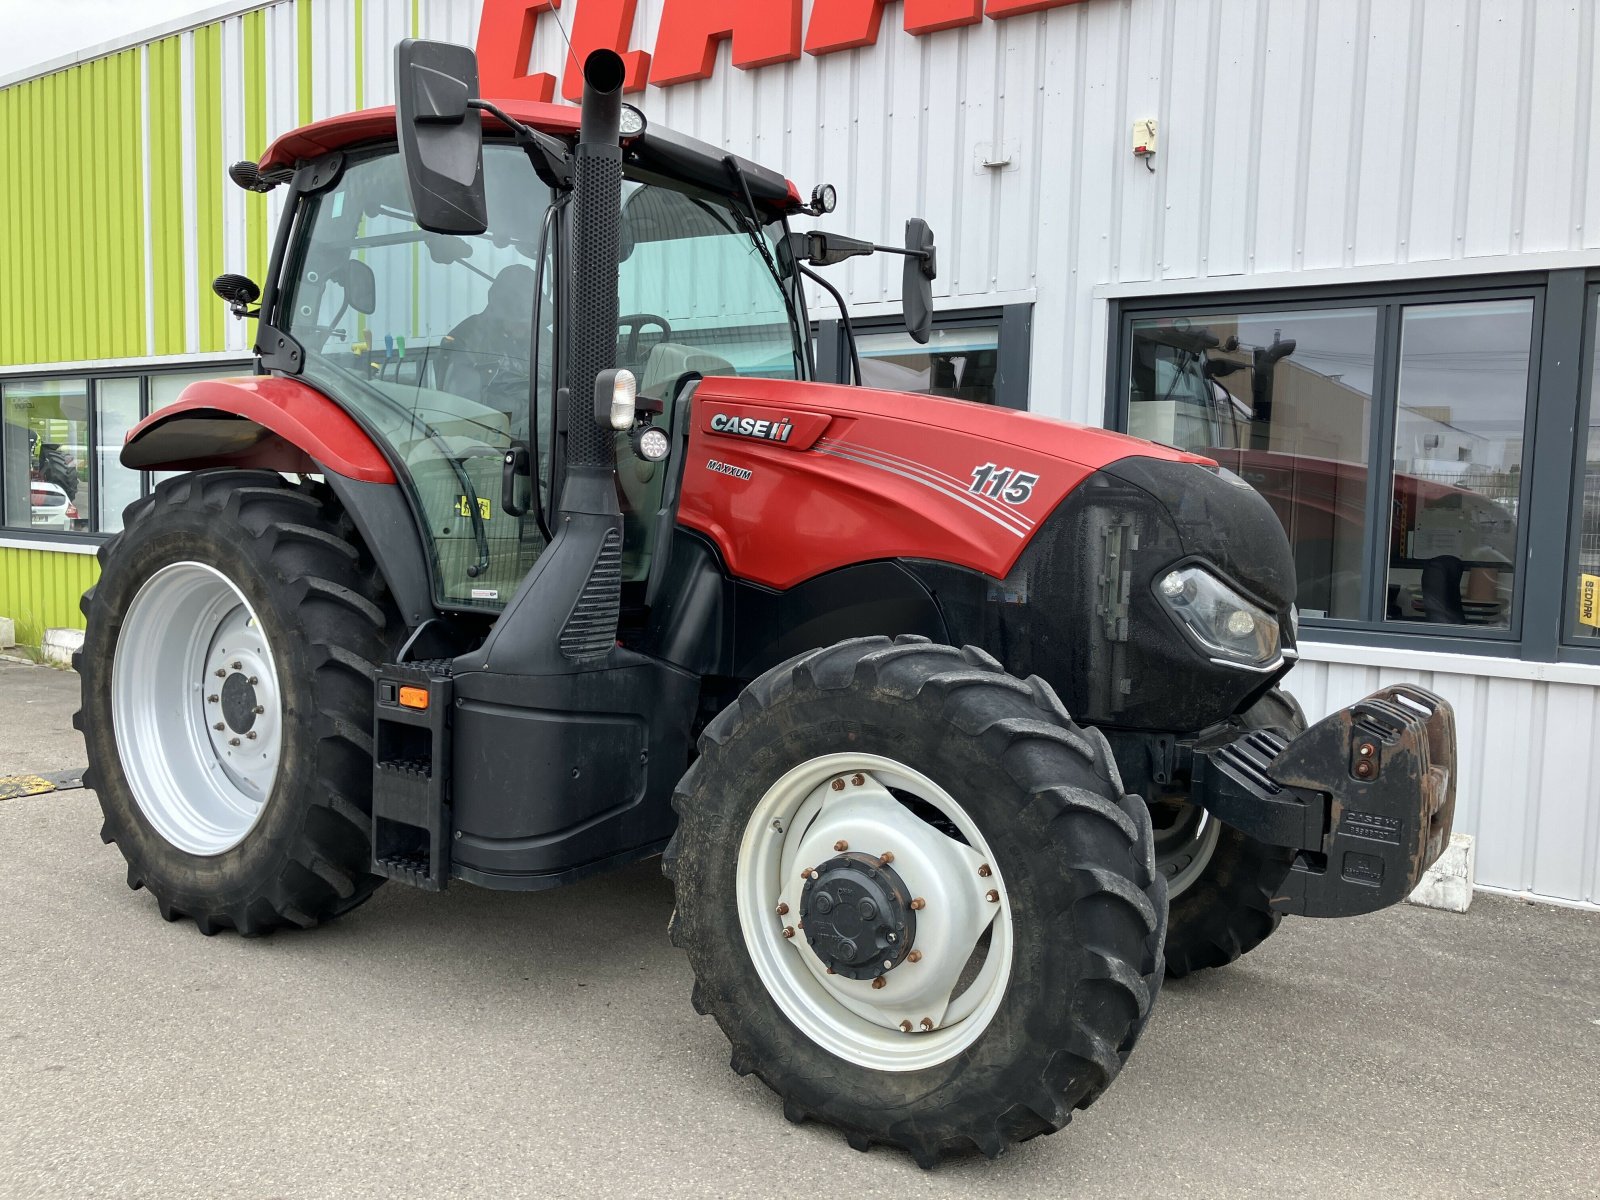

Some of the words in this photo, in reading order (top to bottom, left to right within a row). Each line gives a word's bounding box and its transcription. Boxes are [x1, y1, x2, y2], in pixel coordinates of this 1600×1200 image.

[475, 0, 1091, 103] CLA
[710, 413, 770, 438] CASE
[706, 459, 752, 481] MAXXUM
[968, 462, 1040, 505] 115
